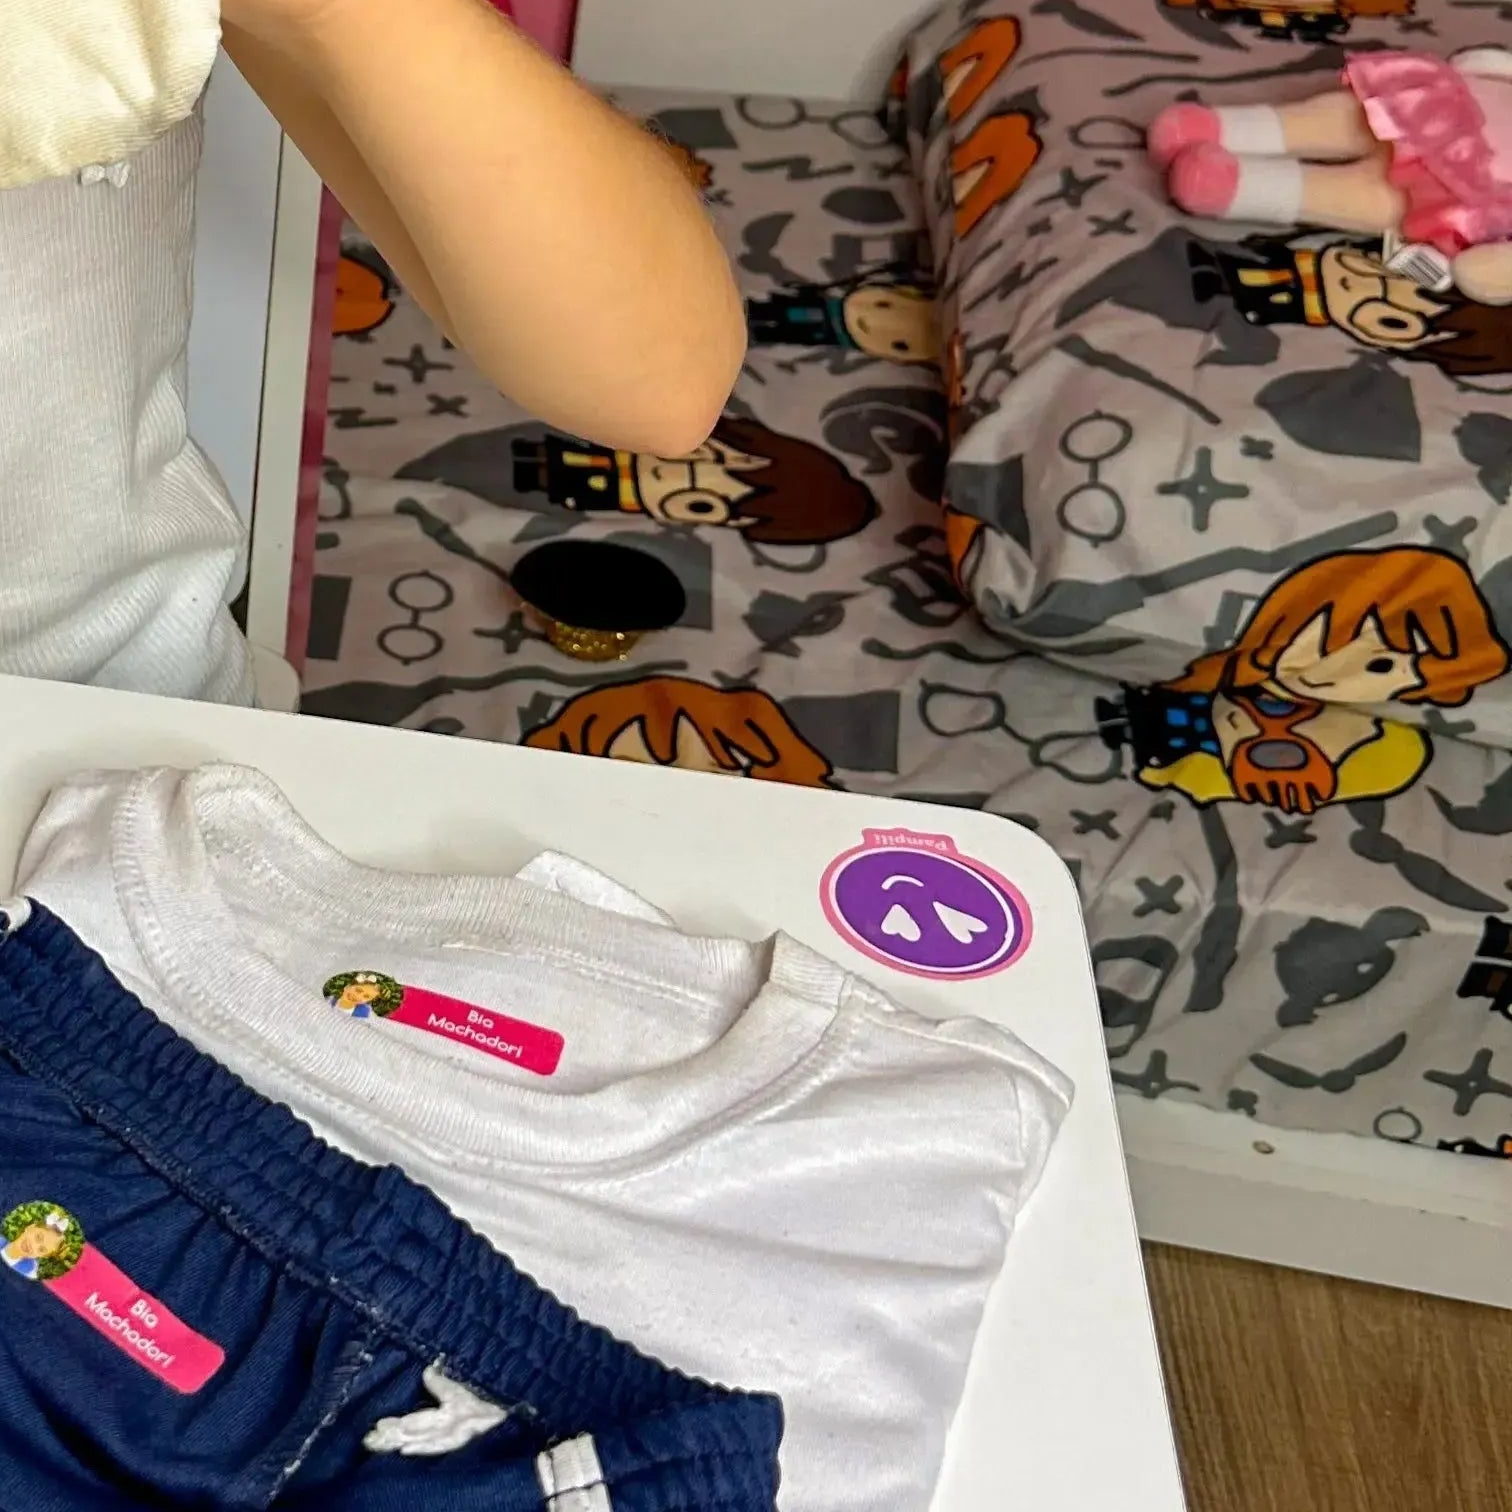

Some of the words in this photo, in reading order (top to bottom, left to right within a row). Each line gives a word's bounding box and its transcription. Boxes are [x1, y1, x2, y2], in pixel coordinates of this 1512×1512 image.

[874, 832, 948, 851] Pampili
[467, 1009, 494, 1029] Bia
[427, 1013, 523, 1059] Machadori
[130, 1299, 159, 1329] Bia
[85, 1292, 175, 1368] Machadori
